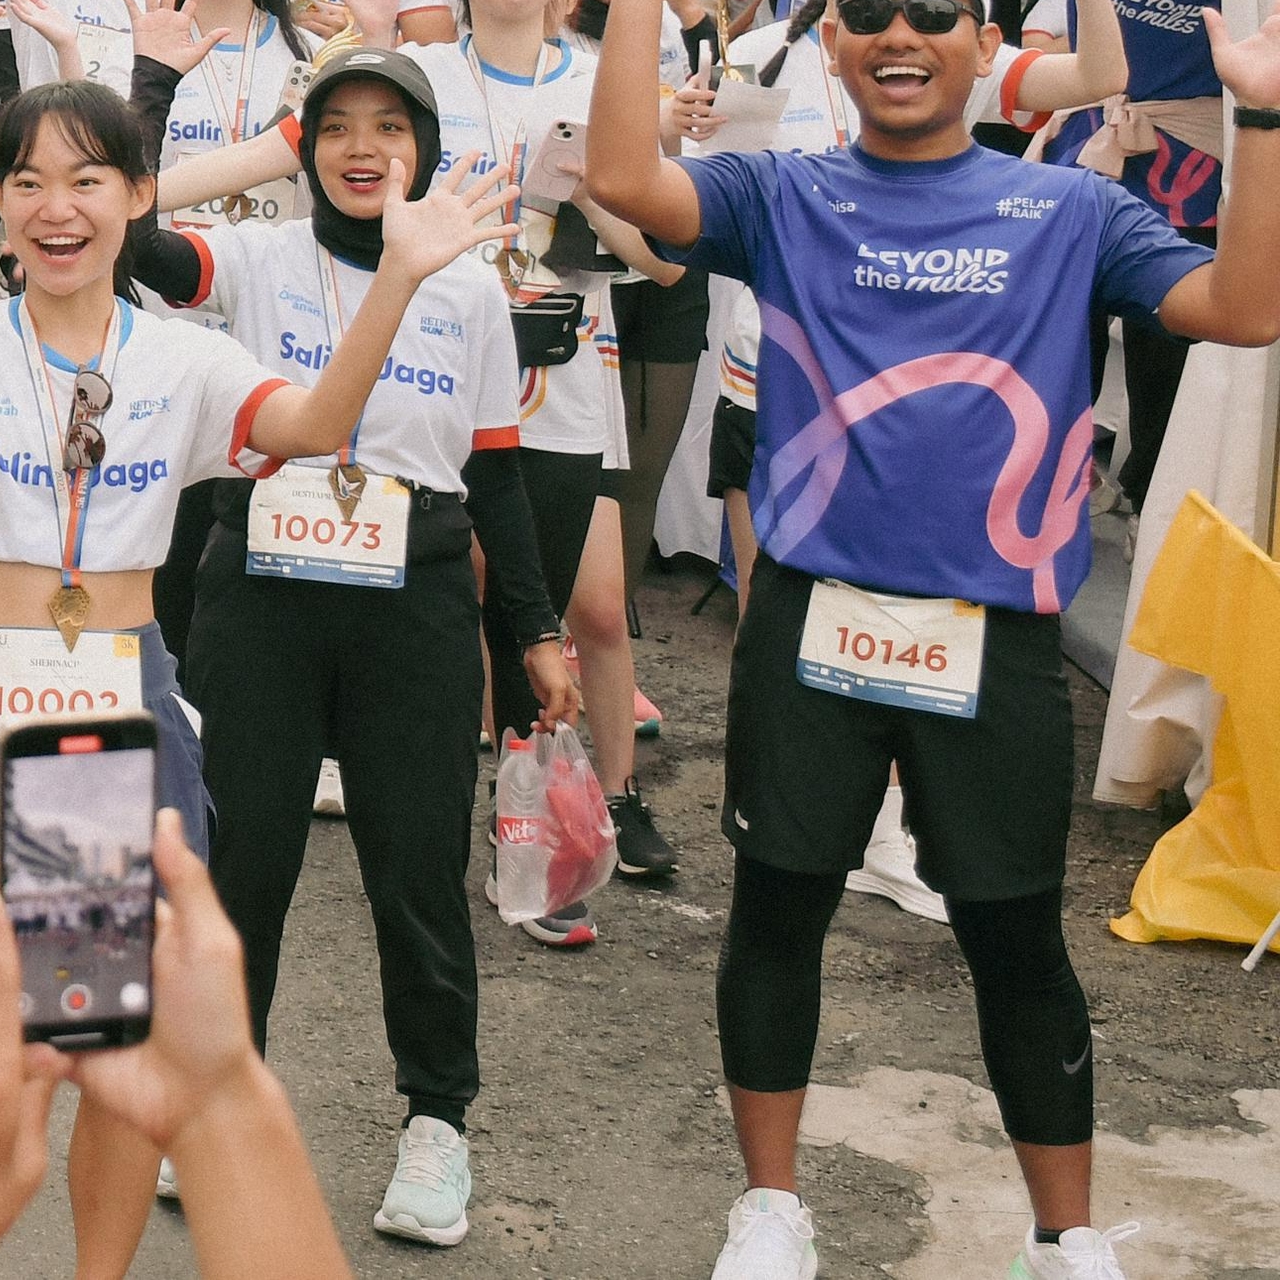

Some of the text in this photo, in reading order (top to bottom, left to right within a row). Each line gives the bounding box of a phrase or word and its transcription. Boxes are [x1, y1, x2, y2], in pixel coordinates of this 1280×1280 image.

[190, 198, 279, 221] 2020
[1012, 208, 1043, 220] BAIK
[853, 265, 901, 291] the
[280, 331, 454, 396] SaliJaga
[270, 512, 382, 550] 10073
[836, 626, 948, 673] 10146
[502, 819, 529, 841] Vit
